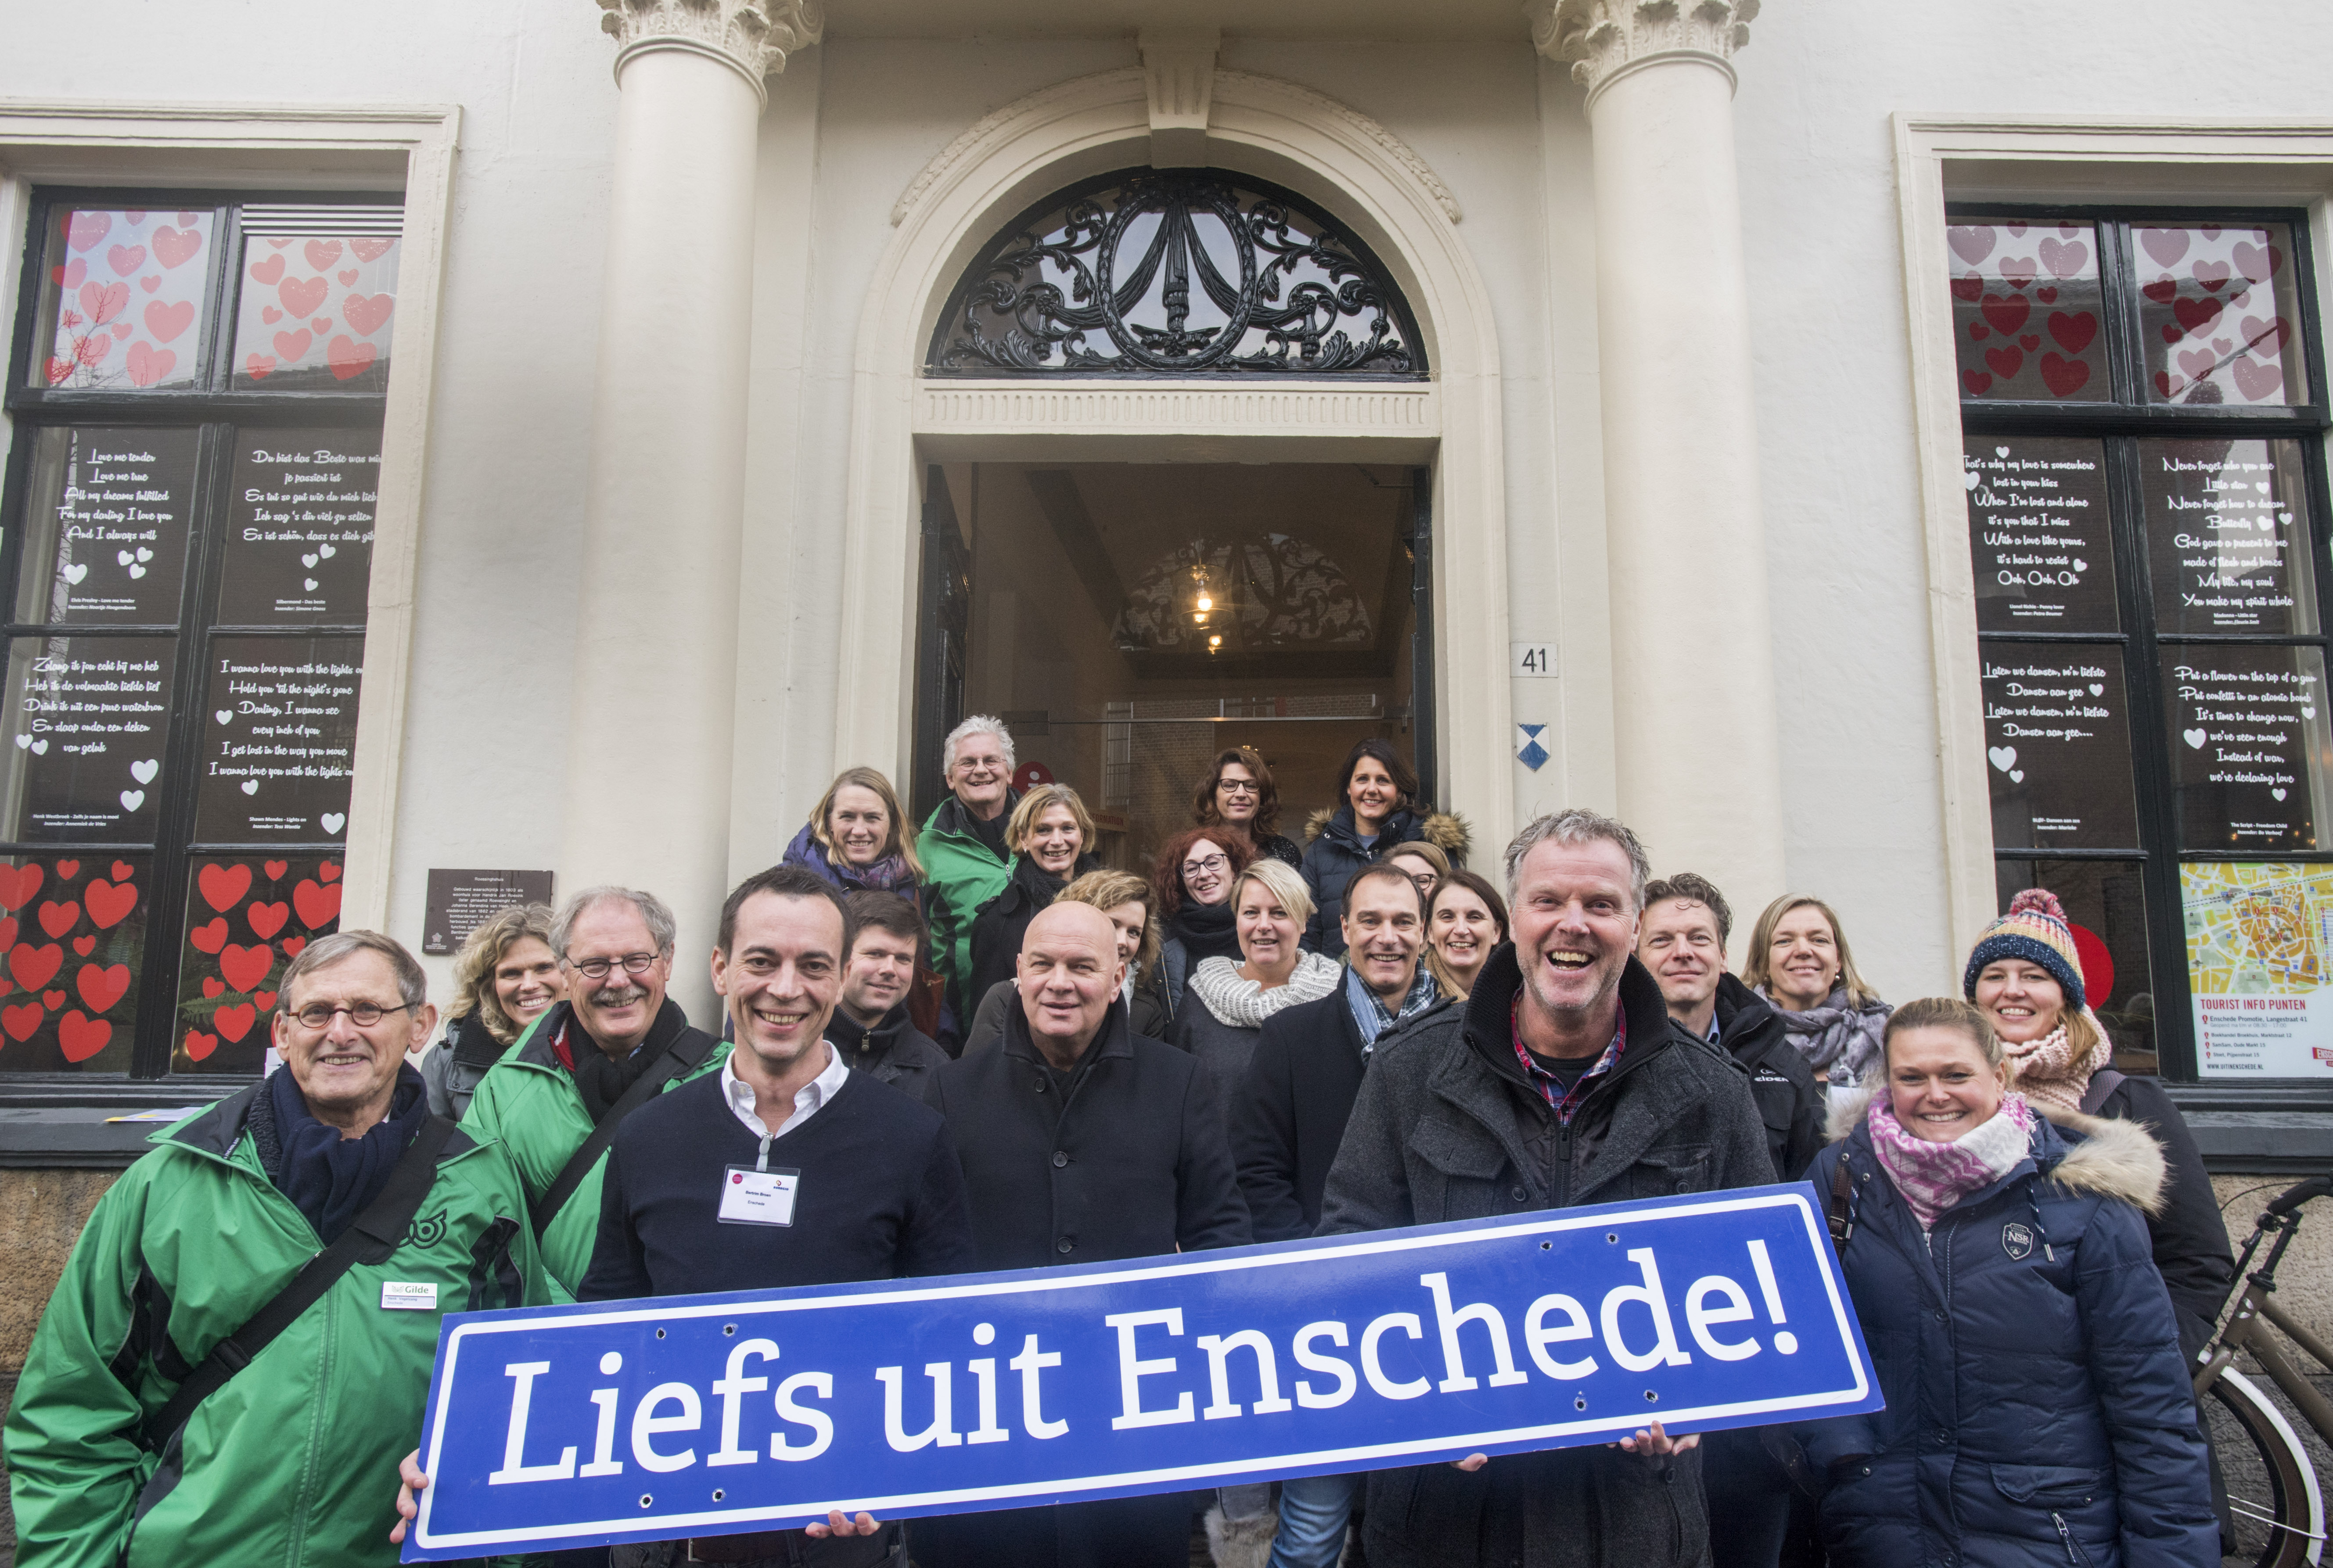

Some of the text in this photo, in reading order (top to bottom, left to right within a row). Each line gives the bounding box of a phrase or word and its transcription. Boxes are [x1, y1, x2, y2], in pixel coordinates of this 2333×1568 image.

[87, 449, 112, 463] Love
[129, 452, 155, 462] tender
[2162, 457, 2197, 471] Never
[2197, 461, 2222, 473] forget
[2223, 460, 2240, 470] who
[2242, 463, 2258, 473] you
[90, 468, 115, 483] Love
[131, 472, 148, 481] true
[285, 473, 341, 484] je passiert ist
[2203, 477, 2248, 492] Little star
[1974, 493, 2089, 507] When I'm lost and alone
[254, 508, 271, 521] Ich
[273, 513, 290, 523] sag
[302, 511, 315, 521] dir
[317, 512, 332, 521] viel
[334, 513, 346, 525] zu
[348, 512, 372, 521] selten
[2205, 515, 2251, 530] Butterfly
[1998, 571, 2079, 586] Ooh, Ooh, Oh
[2197, 572, 2274, 589] My life, my soul
[1522, 648, 1546, 673] 41
[1982, 662, 2011, 678] Laten
[2027, 665, 2060, 677] dansen,
[2081, 666, 2106, 677] liefste
[229, 680, 257, 693] Hold
[259, 686, 274, 696] you
[289, 683, 302, 694] the
[304, 683, 331, 696] night's
[333, 688, 353, 696] gone
[2006, 683, 2048, 696] Dansen
[2068, 689, 2084, 701] zee
[238, 701, 282, 716] Darling,
[285, 701, 294, 714] I
[32, 719, 53, 732] En
[55, 722, 79, 733] slaap
[82, 722, 105, 732] onder
[124, 722, 150, 732] deken
[2210, 730, 2235, 741] we've
[2257, 732, 2287, 745] enough
[82, 742, 106, 754] geluk
[2216, 748, 2253, 762] Instead
[2254, 752, 2262, 763] of
[2210, 771, 2294, 785] we're declaring love
[2200, 999, 2306, 1010] TOURIST INFO PUNTEN
[2008, 1231, 2029, 1243] NSR
[489, 1239, 1801, 1485] Liefs uit Enschede!
